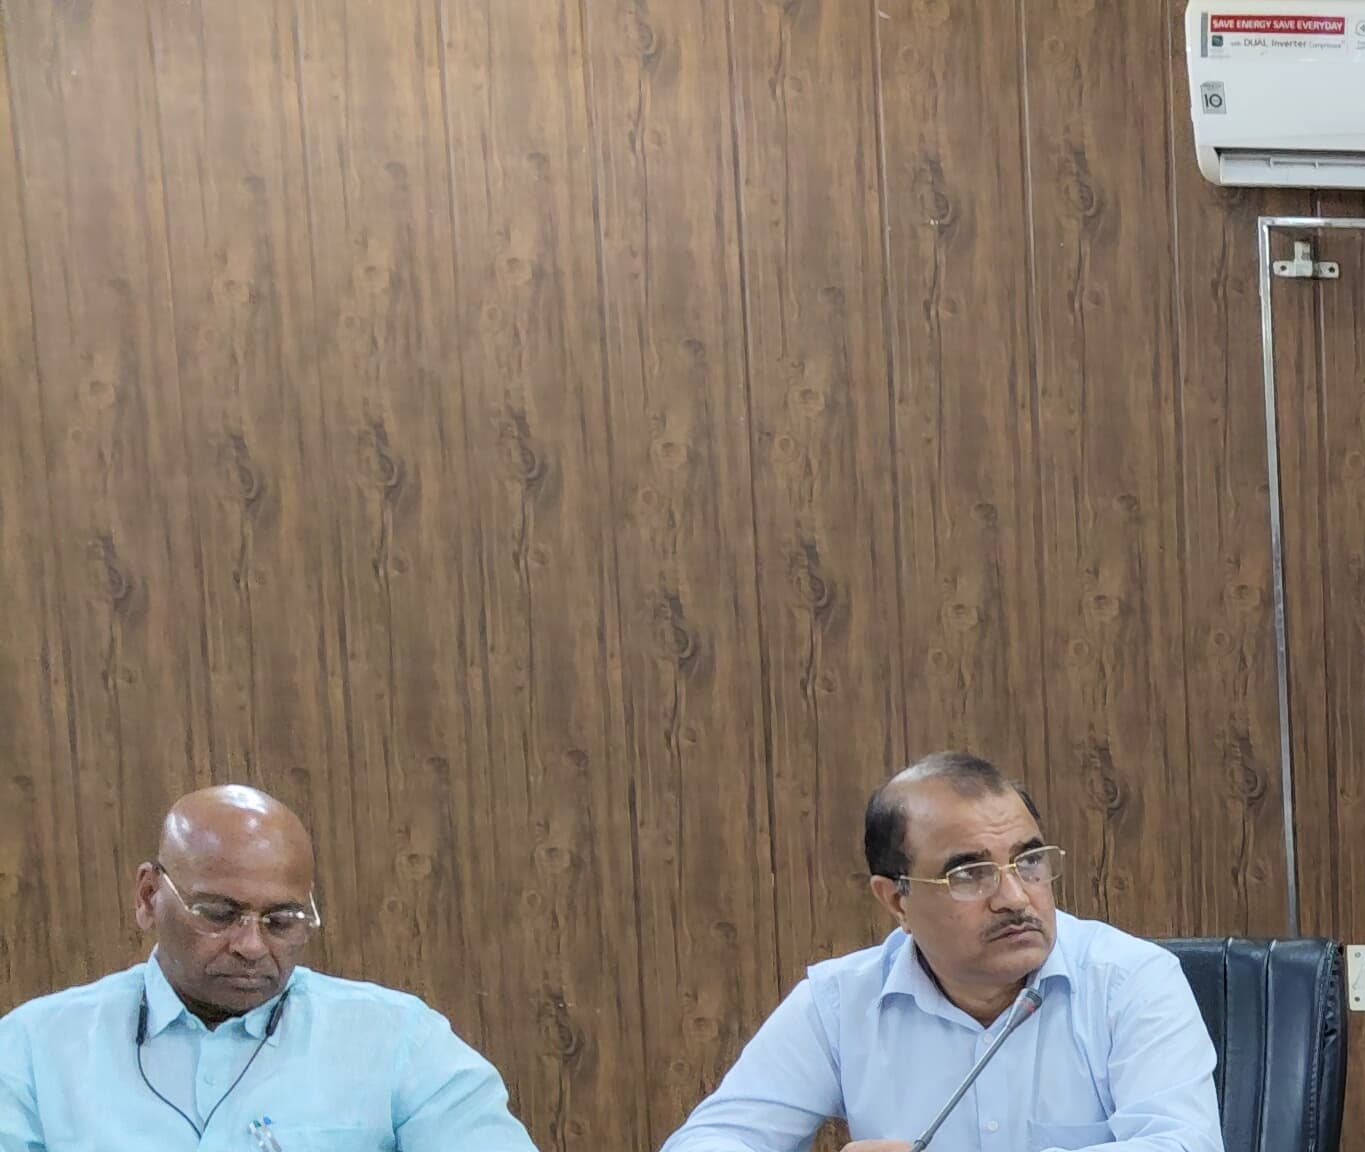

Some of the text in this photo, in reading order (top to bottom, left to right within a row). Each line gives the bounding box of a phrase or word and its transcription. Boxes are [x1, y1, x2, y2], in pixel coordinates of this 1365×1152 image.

[1212, 20, 1343, 31] SAVE ENERGY SAVE EVERYDAY
[1244, 38, 1267, 47] DUAL
[1272, 39, 1307, 49] Inverter
